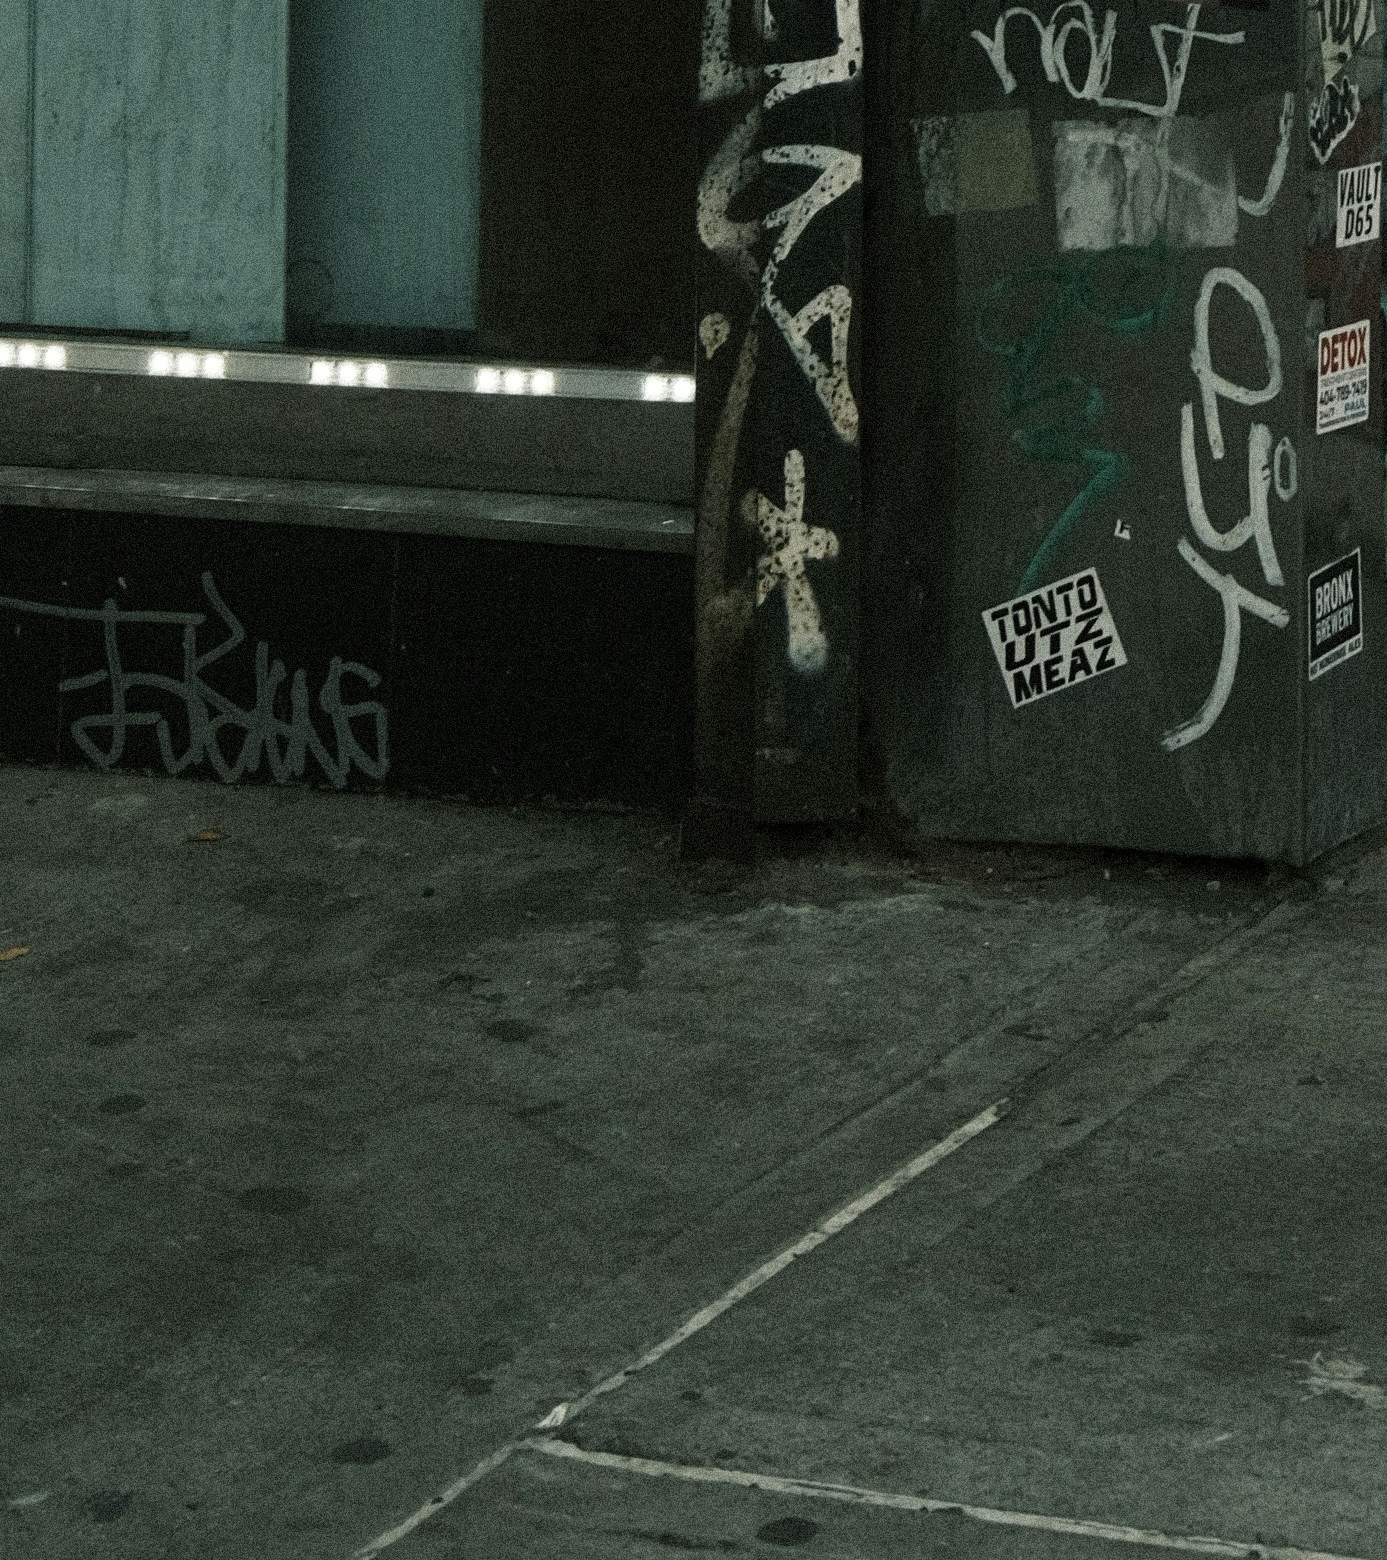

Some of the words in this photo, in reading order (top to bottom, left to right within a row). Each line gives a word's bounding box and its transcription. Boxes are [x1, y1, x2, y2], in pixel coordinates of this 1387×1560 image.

[1320, 326, 1367, 376] DETOX
[990, 572, 1099, 642] TONTO
[1314, 568, 1355, 620] BRONX
[1002, 614, 1104, 667] UTZ
[1012, 644, 1116, 702] MEAZ
